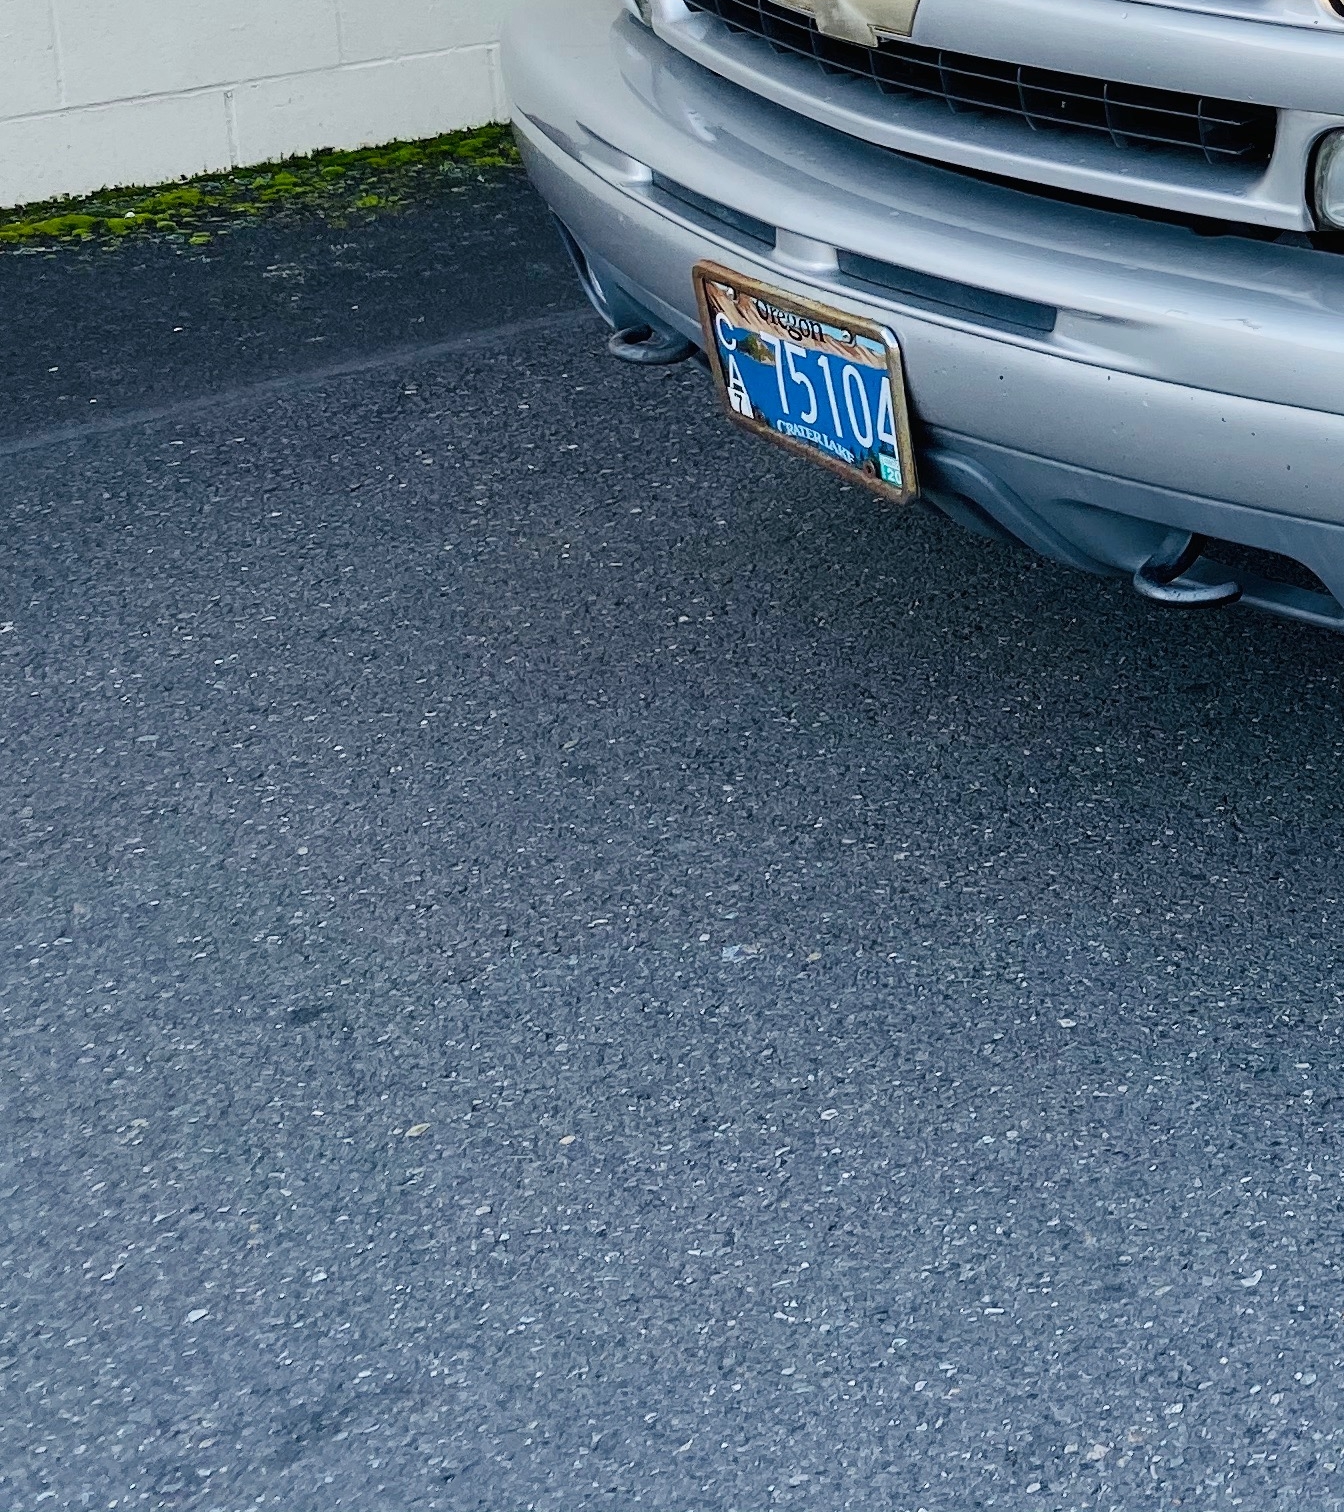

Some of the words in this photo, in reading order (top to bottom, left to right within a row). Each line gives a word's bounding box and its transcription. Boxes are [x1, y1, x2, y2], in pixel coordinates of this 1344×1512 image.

[756, 299, 826, 343] Oregon
[760, 330, 900, 459] 75104
[776, 419, 822, 443] CRATER
[821, 434, 855, 464] LAKE
